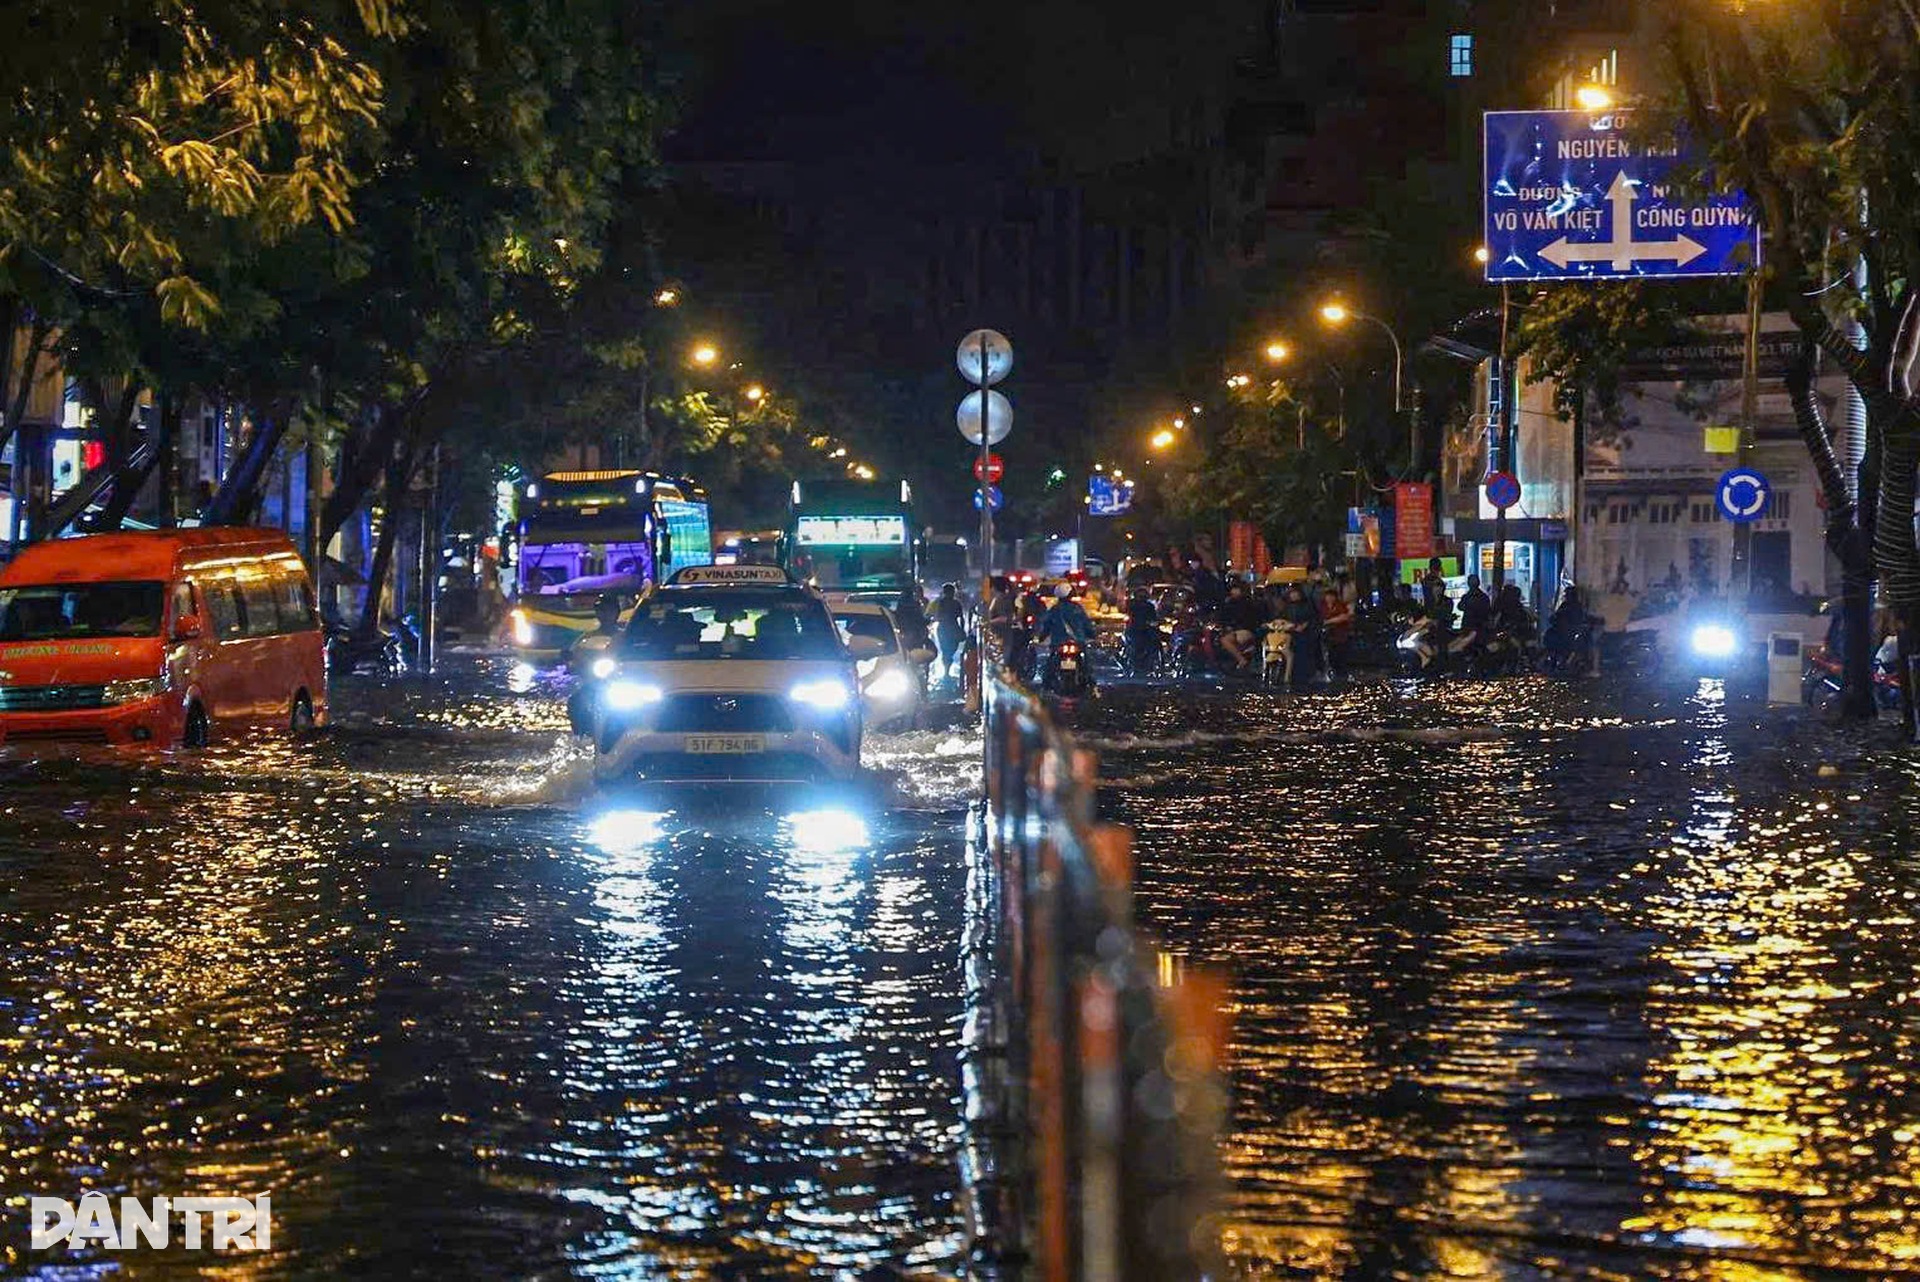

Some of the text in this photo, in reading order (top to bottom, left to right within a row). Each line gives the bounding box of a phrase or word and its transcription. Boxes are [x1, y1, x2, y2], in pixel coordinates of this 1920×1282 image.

[1557, 132, 1630, 159] NGUYỄN
[1493, 207, 1518, 231] VÕ
[1564, 206, 1604, 232] KIỆT
[1637, 201, 1686, 228] CỐNG
